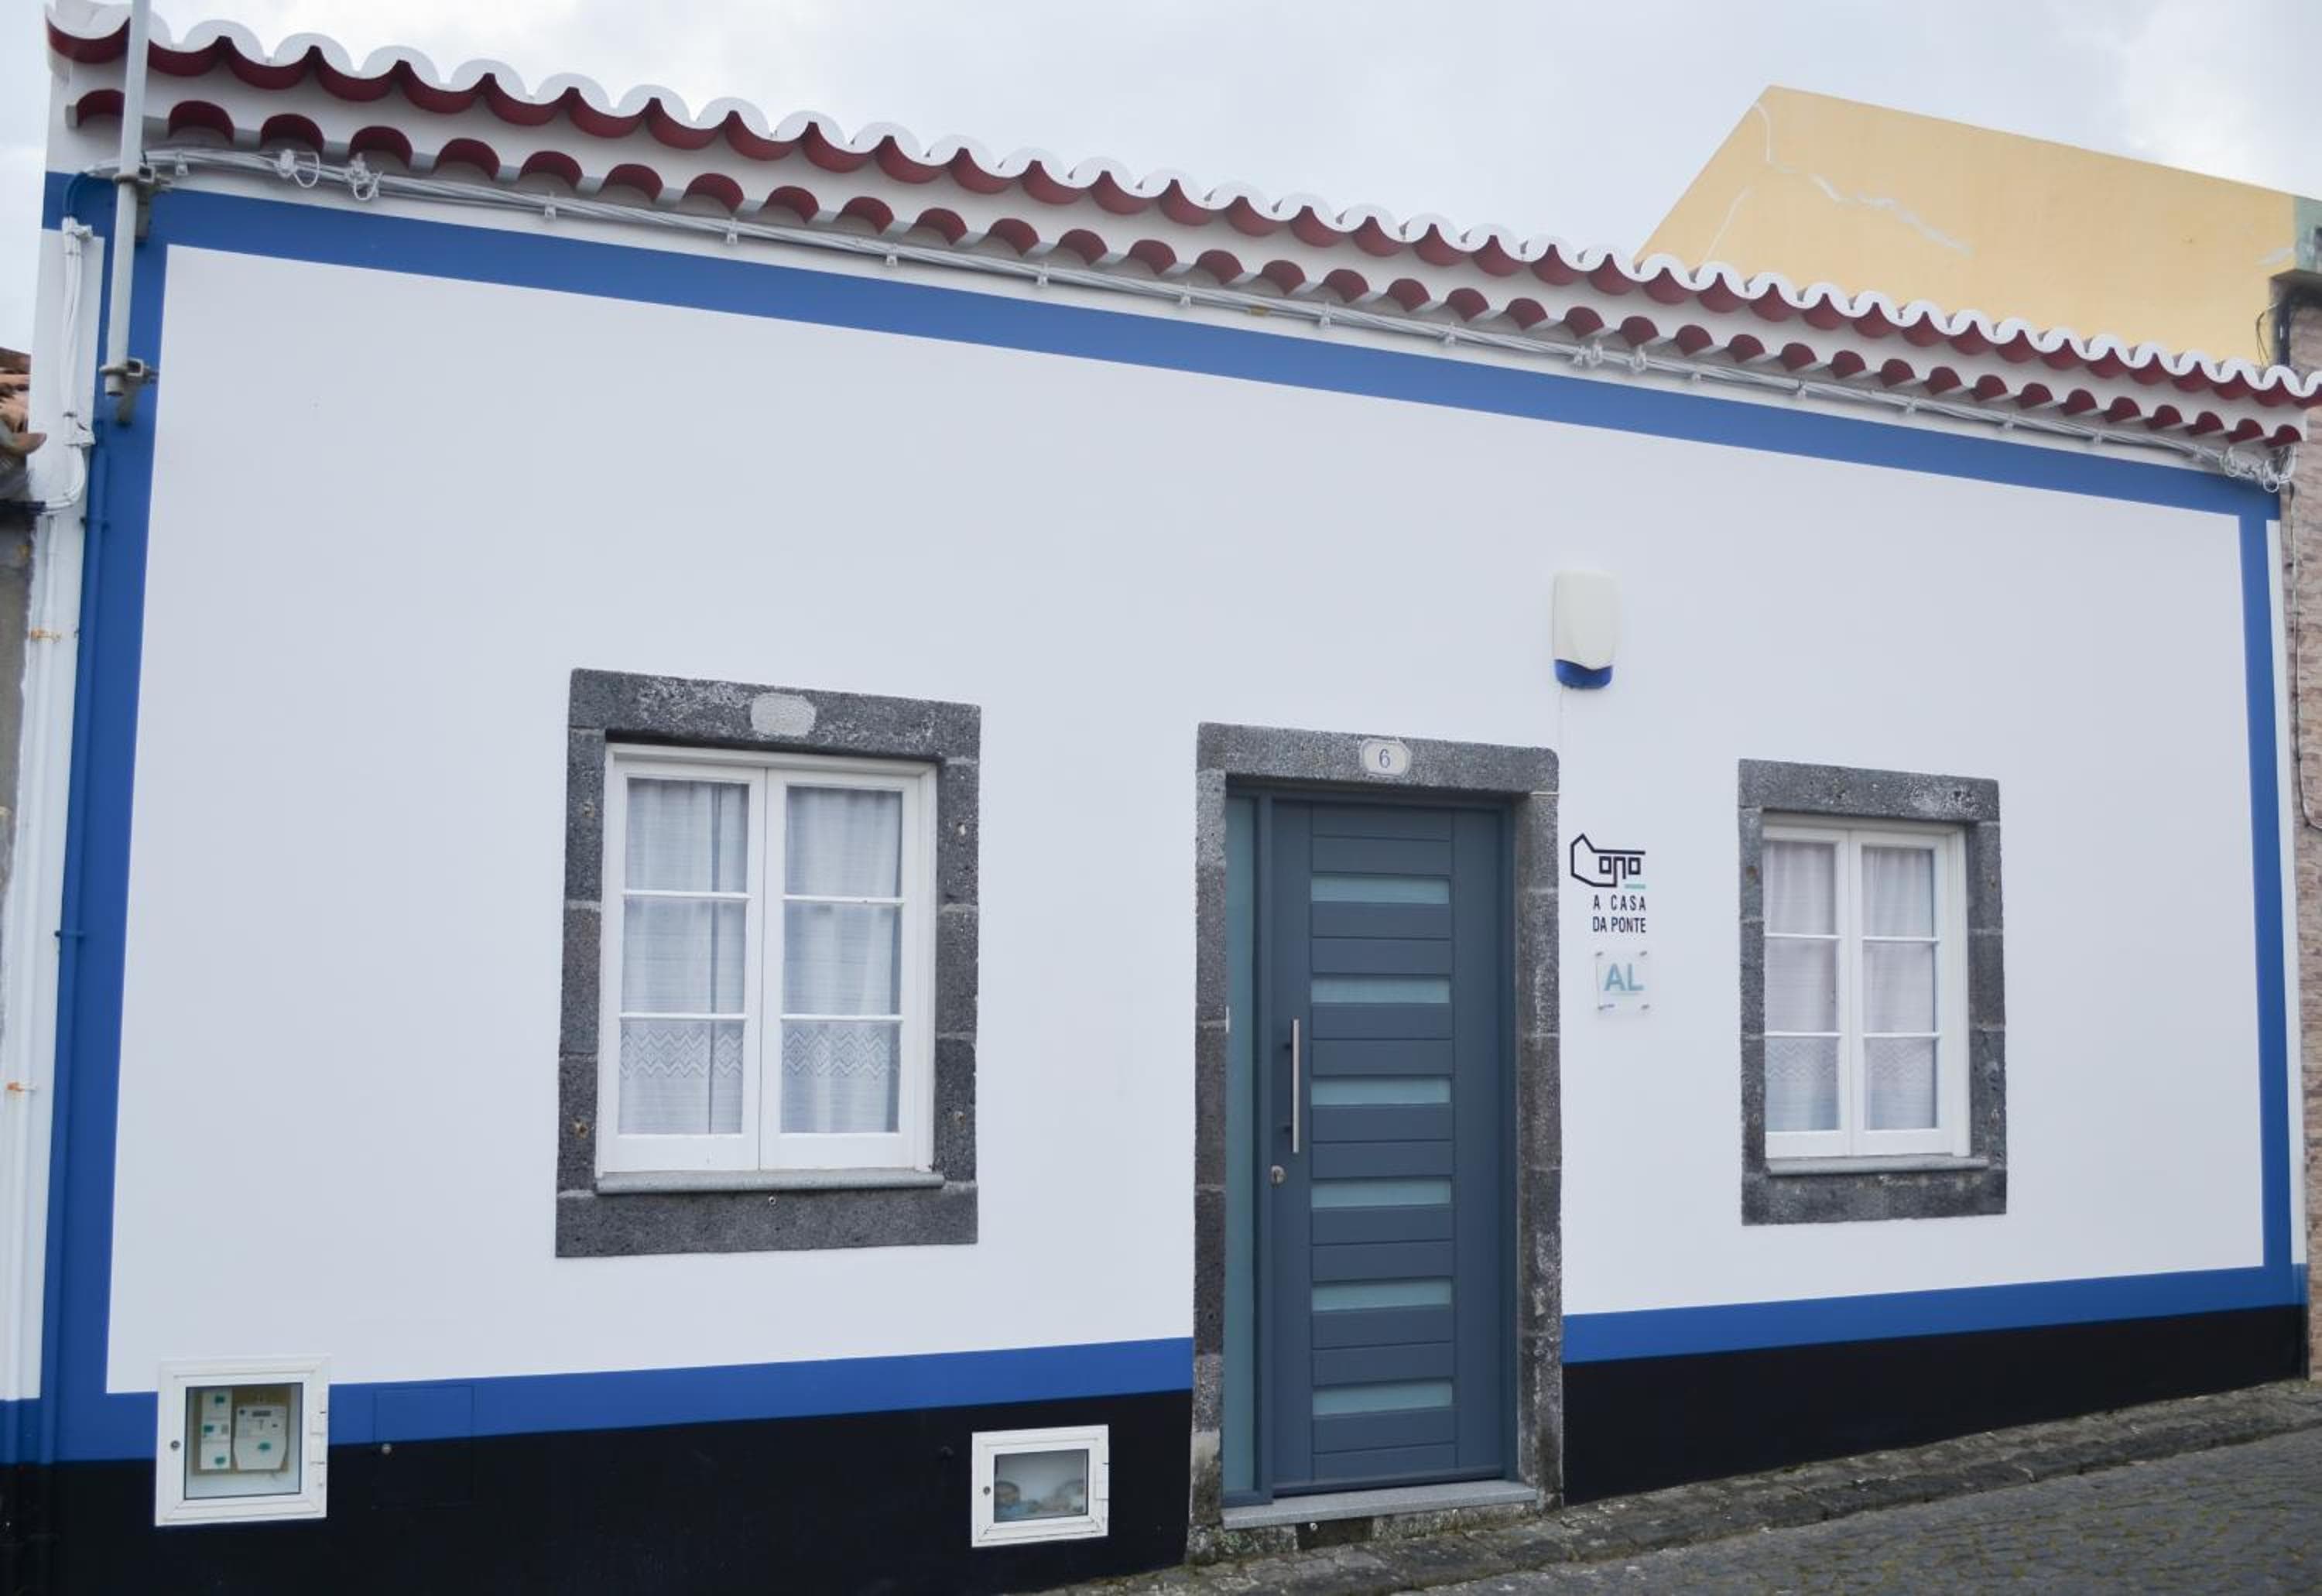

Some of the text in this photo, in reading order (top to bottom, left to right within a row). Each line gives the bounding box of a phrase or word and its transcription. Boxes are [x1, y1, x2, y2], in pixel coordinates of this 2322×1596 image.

[1378, 748, 1391, 769] 6
[1593, 894, 1646, 911] A CASA
[1593, 916, 1646, 933] DA PONTE
[1604, 963, 1644, 992] AL
